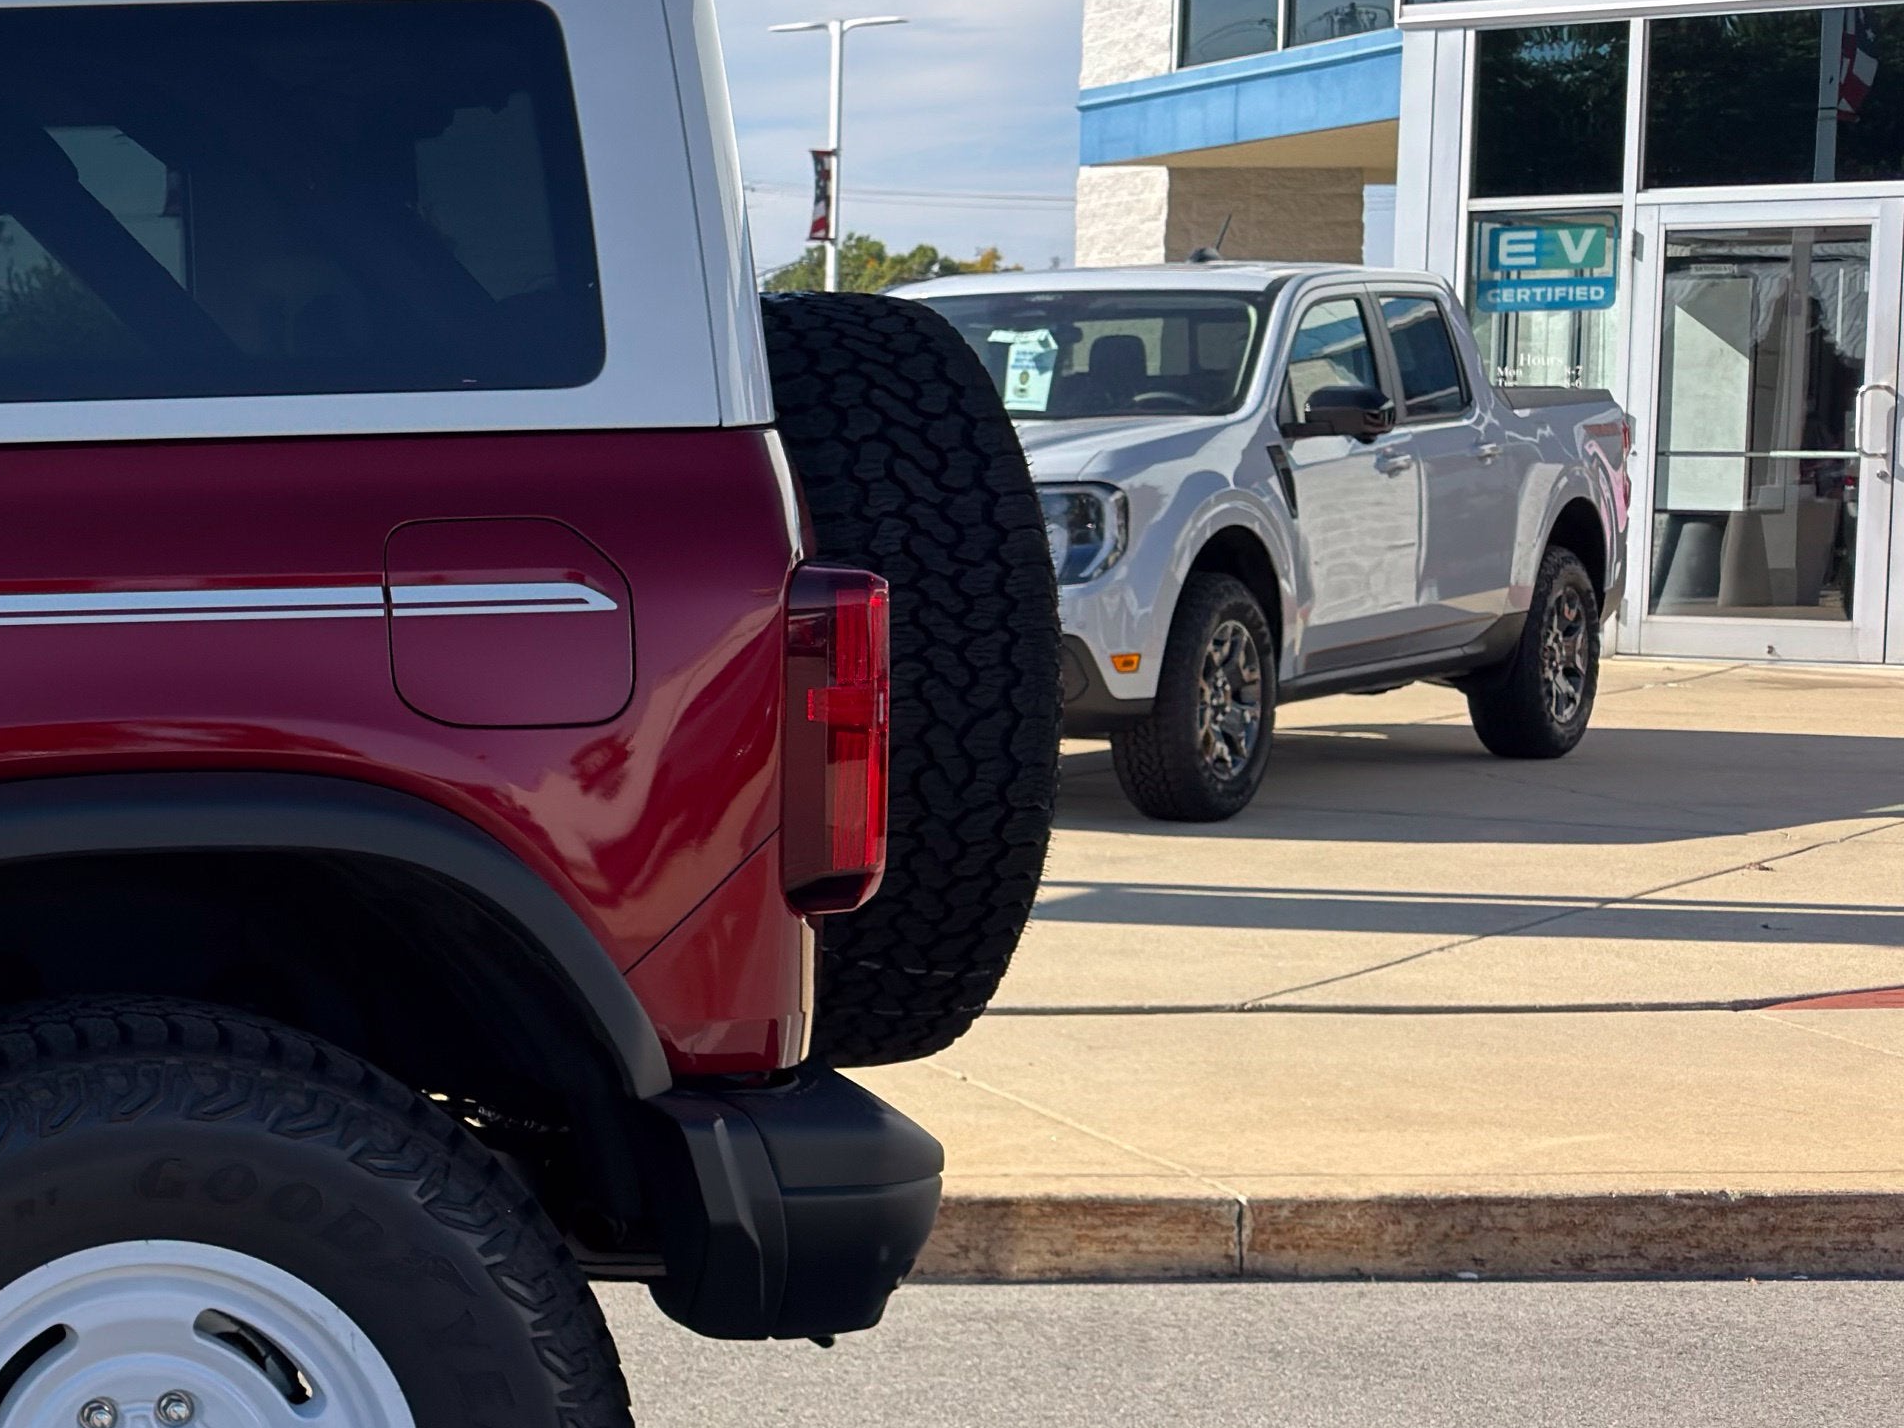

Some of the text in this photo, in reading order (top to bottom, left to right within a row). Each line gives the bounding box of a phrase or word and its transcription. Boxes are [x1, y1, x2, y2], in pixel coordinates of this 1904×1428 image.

[1498, 228, 1598, 266] EV
[1486, 285, 1606, 303] CERTIFIED
[1518, 352, 1563, 366] Hours
[1497, 366, 1523, 377] Mon
